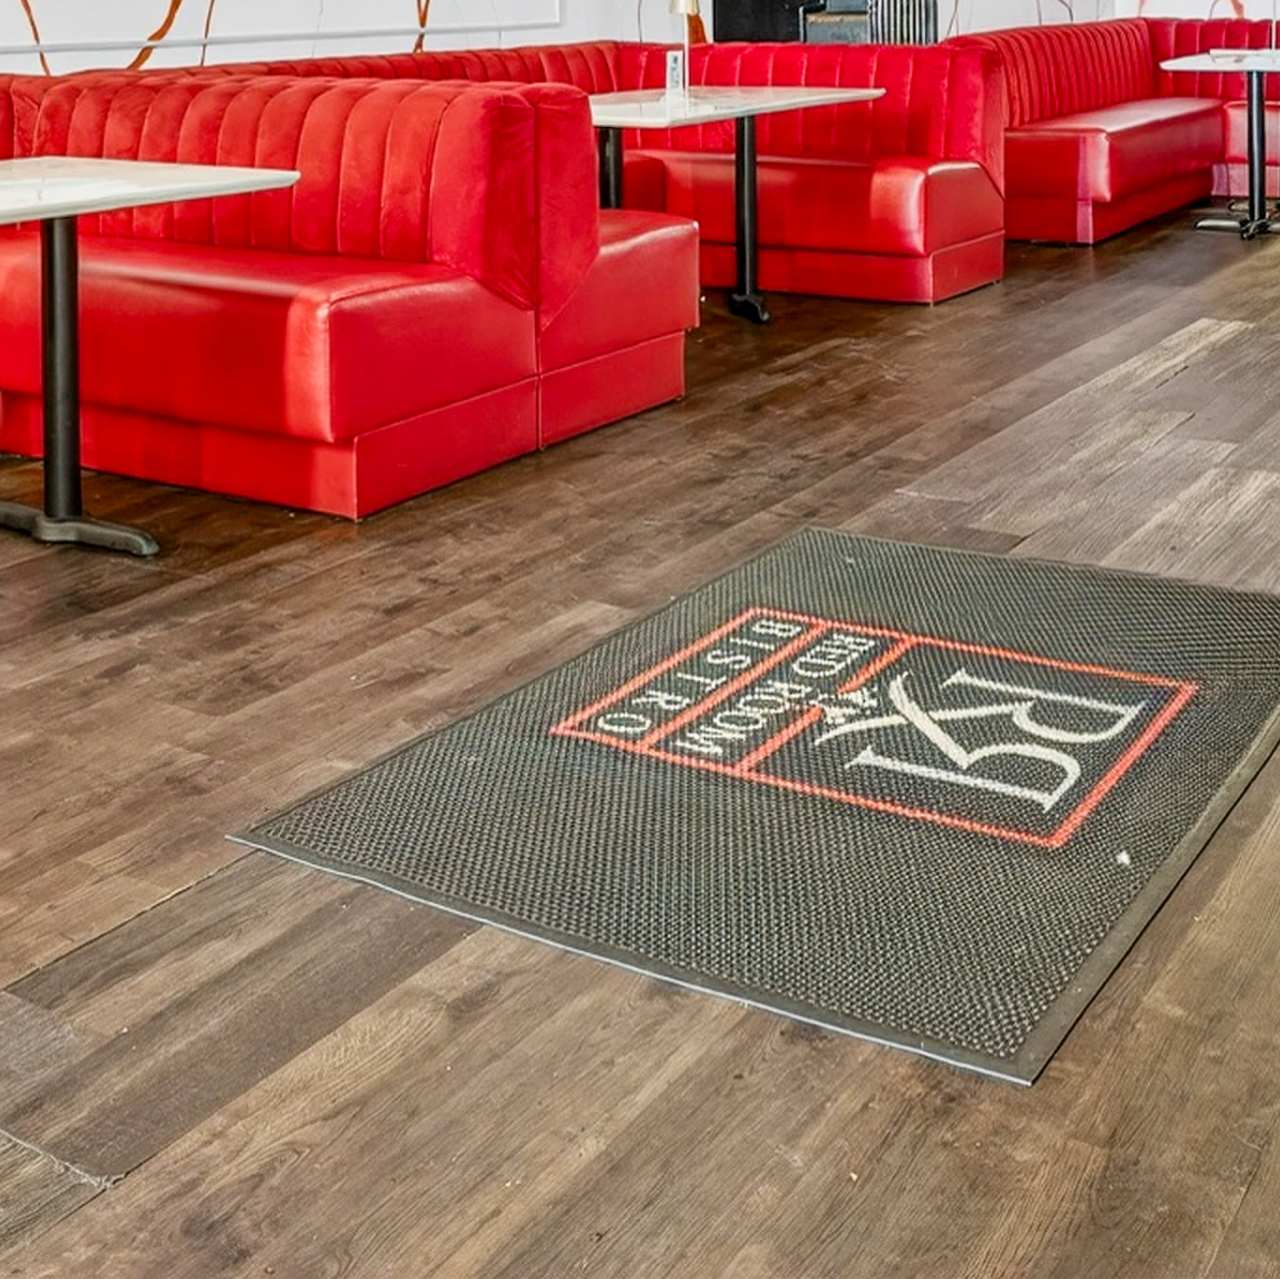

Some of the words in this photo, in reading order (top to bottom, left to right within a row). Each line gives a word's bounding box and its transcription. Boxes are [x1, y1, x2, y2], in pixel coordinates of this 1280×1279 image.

[596, 619, 803, 735] BISTRO
[792, 632, 877, 678] RED
[675, 680, 812, 756] ROOM
